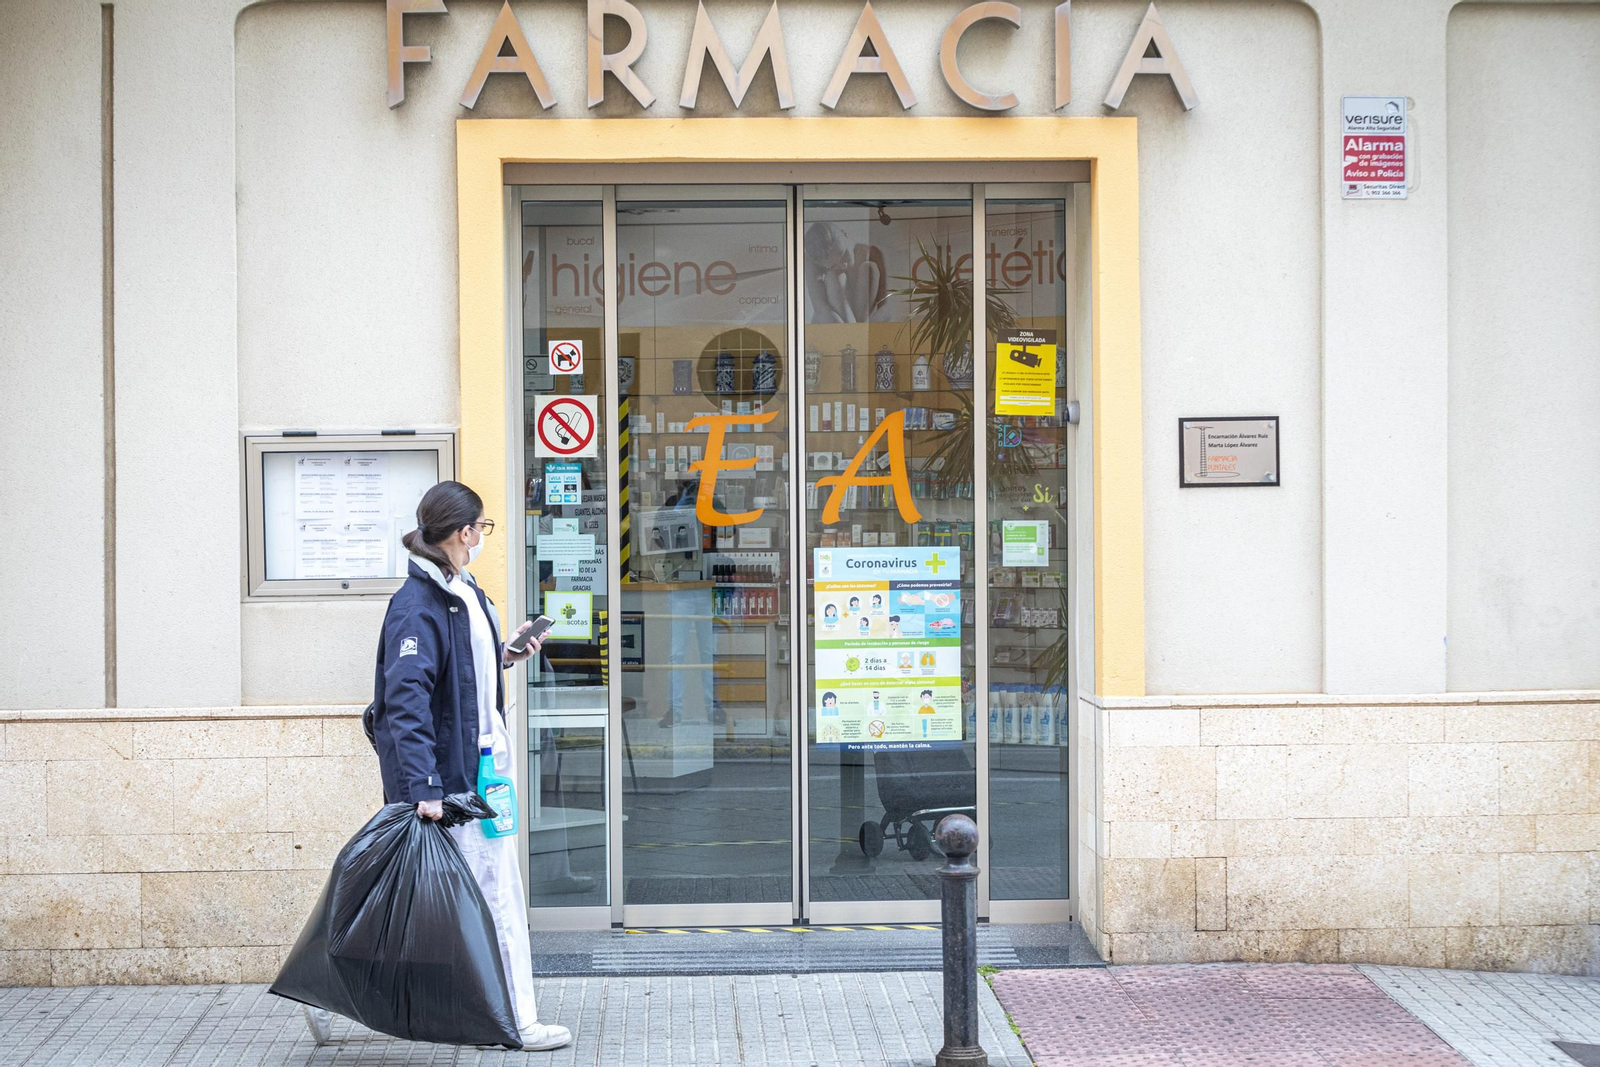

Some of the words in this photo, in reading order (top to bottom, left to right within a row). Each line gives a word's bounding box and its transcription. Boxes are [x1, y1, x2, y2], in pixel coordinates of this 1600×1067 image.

[386, 0, 1200, 110] FARMACIA
[1345, 115, 1402, 124] verisure
[1345, 138, 1403, 151] Alarma
[566, 237, 594, 246] bucal
[552, 253, 737, 307] higiene
[738, 296, 779, 306] corporal
[814, 410, 922, 524] A
[846, 558, 917, 568] Coronavirus
